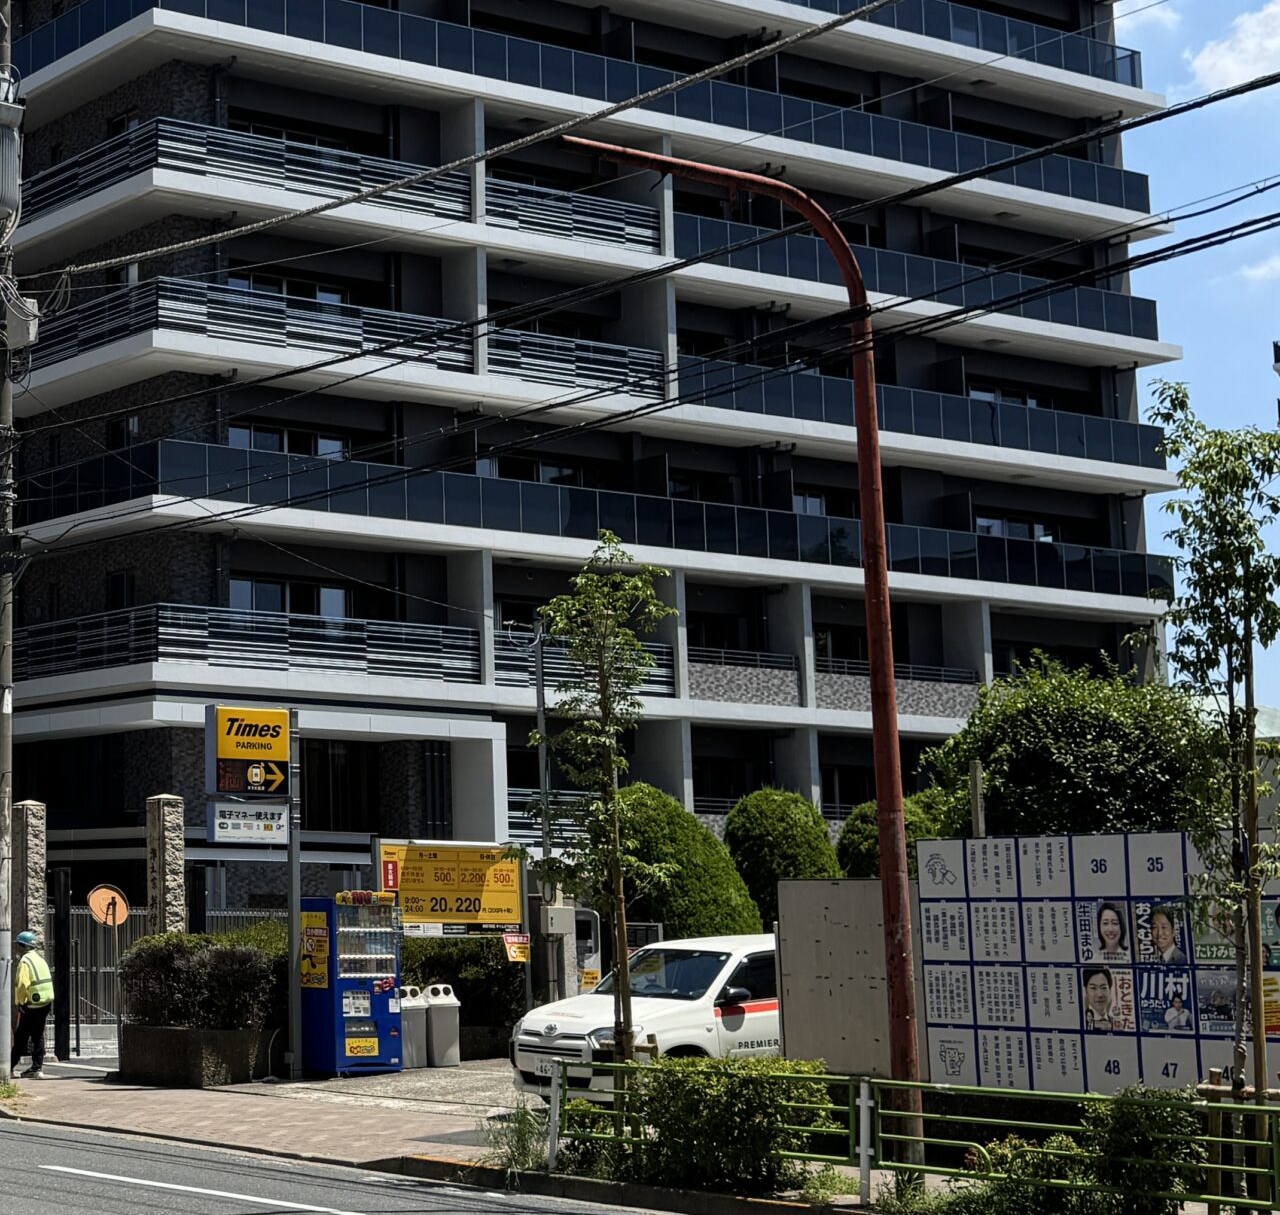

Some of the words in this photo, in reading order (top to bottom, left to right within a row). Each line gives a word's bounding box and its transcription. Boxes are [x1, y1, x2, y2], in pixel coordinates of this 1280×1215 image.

[225, 717, 282, 738] Times
[235, 741, 272, 751] PARKING
[218, 811, 283, 822] 電子マネー使えます
[1090, 858, 1107, 873] 36
[1147, 857, 1163, 872] 35
[434, 872, 451, 882] 500
[460, 872, 486, 884] 2,200
[493, 873, 511, 883] 500
[430, 897, 447, 913] 20
[455, 897, 481, 913] 220
[1136, 902, 1154, 954] おくむら
[1141, 972, 1189, 1001] 川村
[1119, 976, 1135, 1029] おときた
[738, 1038, 779, 1050] PREMIER
[1104, 1060, 1120, 1075] 48
[1161, 1062, 1178, 1078] 47
